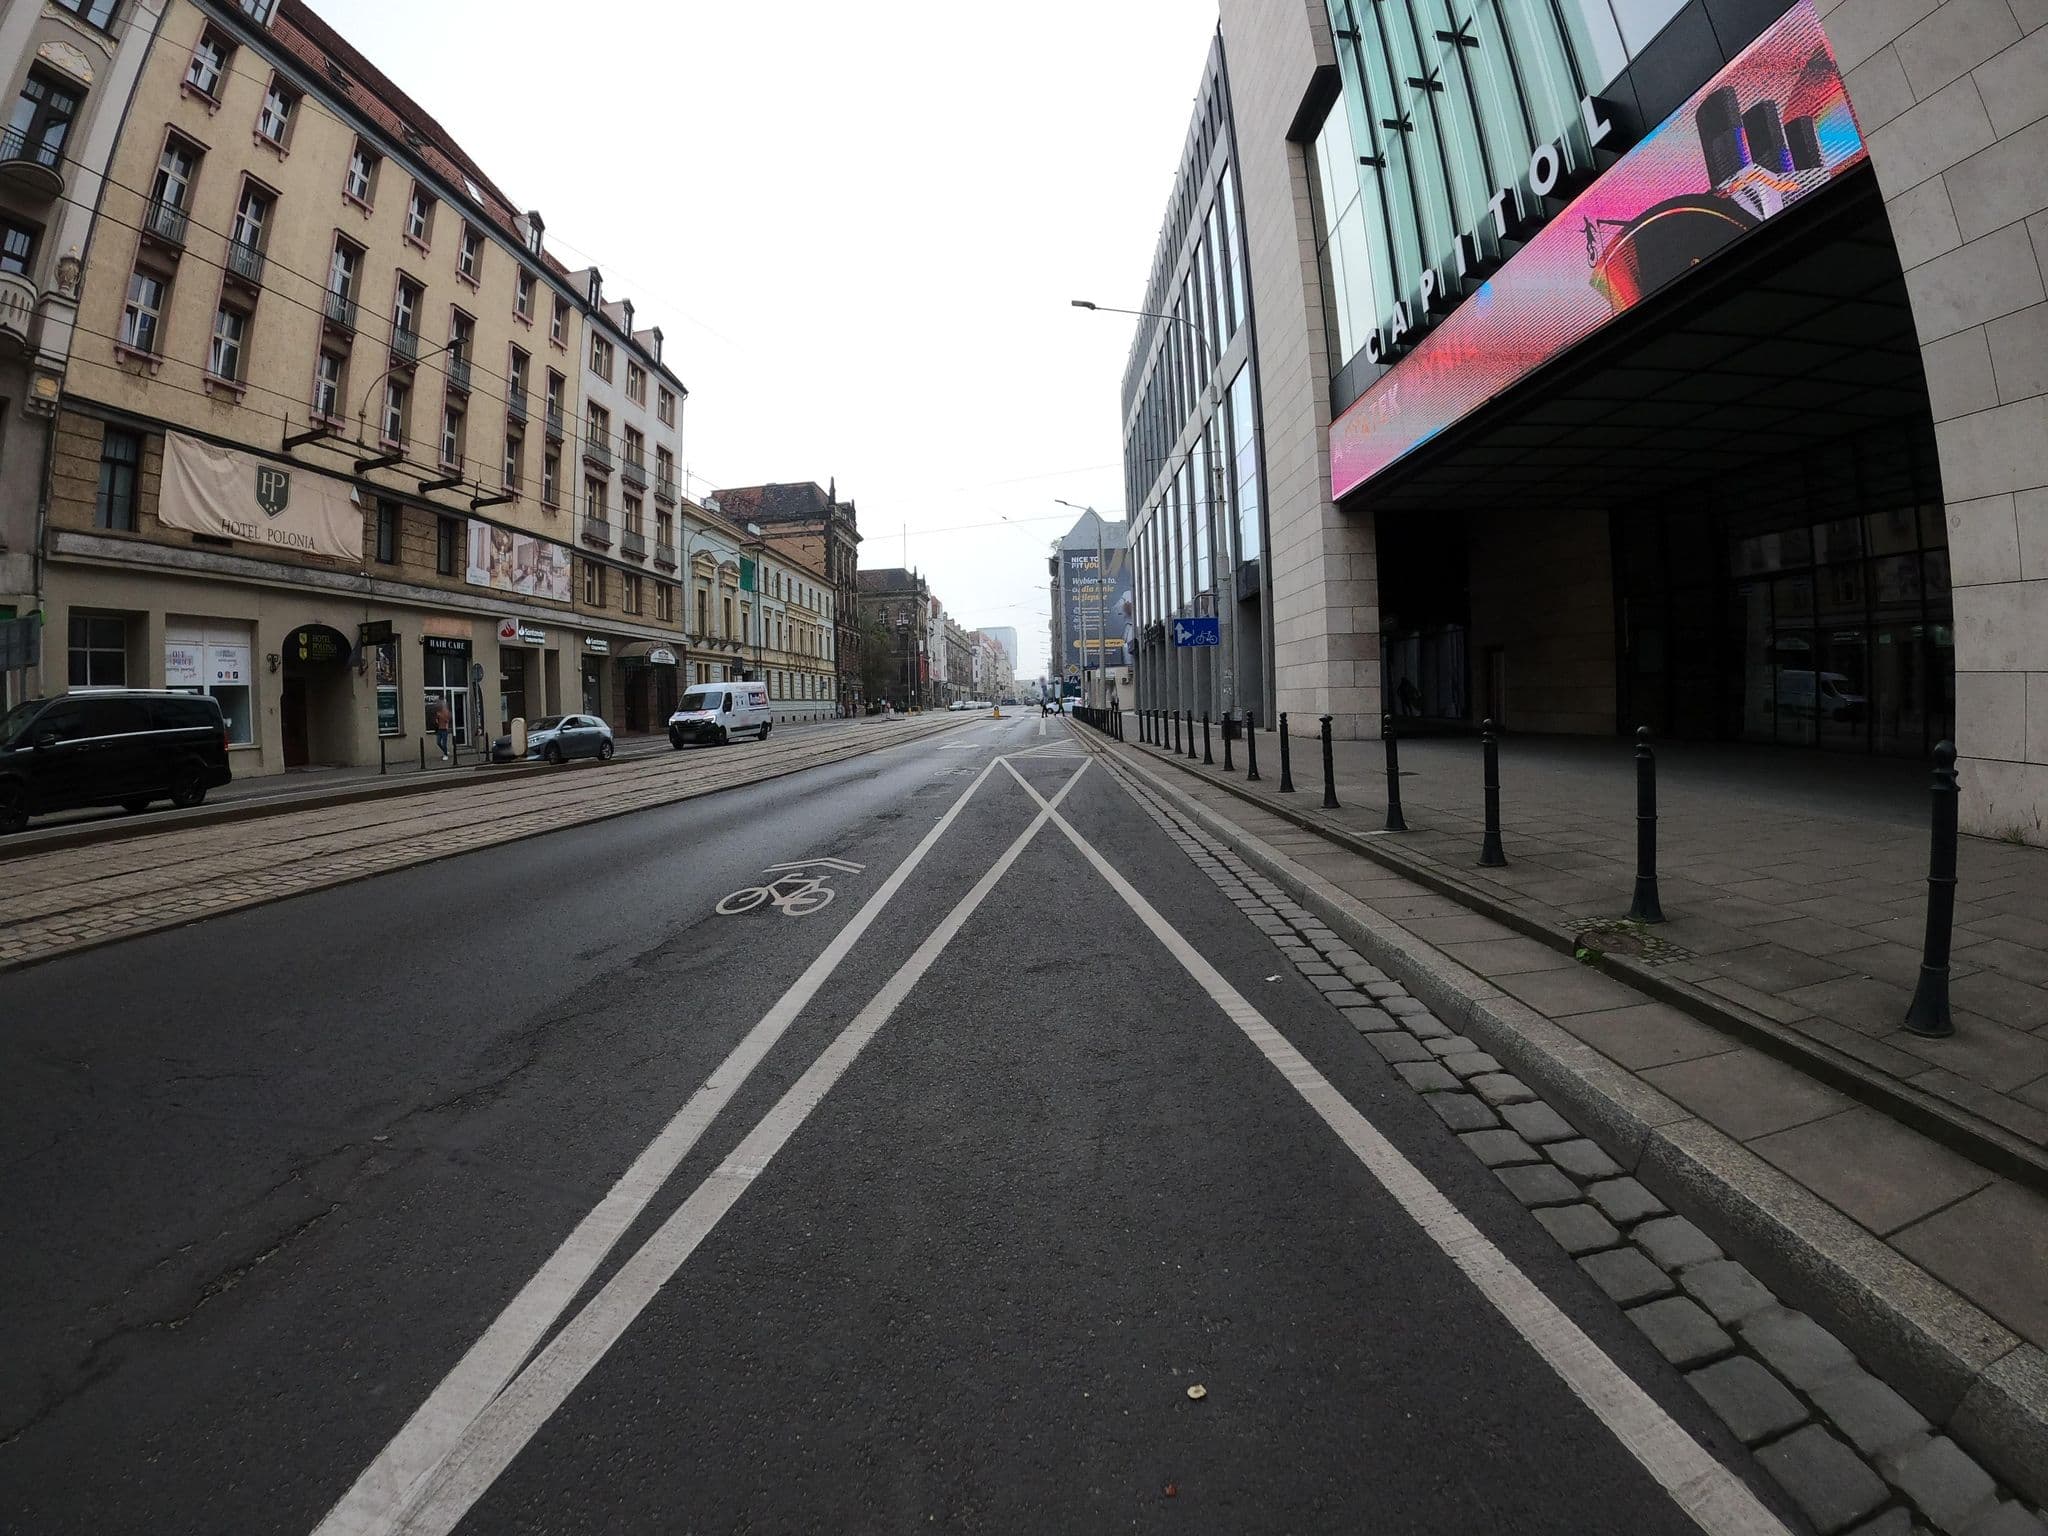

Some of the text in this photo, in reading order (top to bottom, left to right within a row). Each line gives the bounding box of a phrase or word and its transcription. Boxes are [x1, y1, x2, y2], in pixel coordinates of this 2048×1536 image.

[1366, 95, 1612, 364] CAPITOL
[221, 519, 315, 549] HOTEL POLONIA
[430, 639, 465, 650] HAIR CARE
